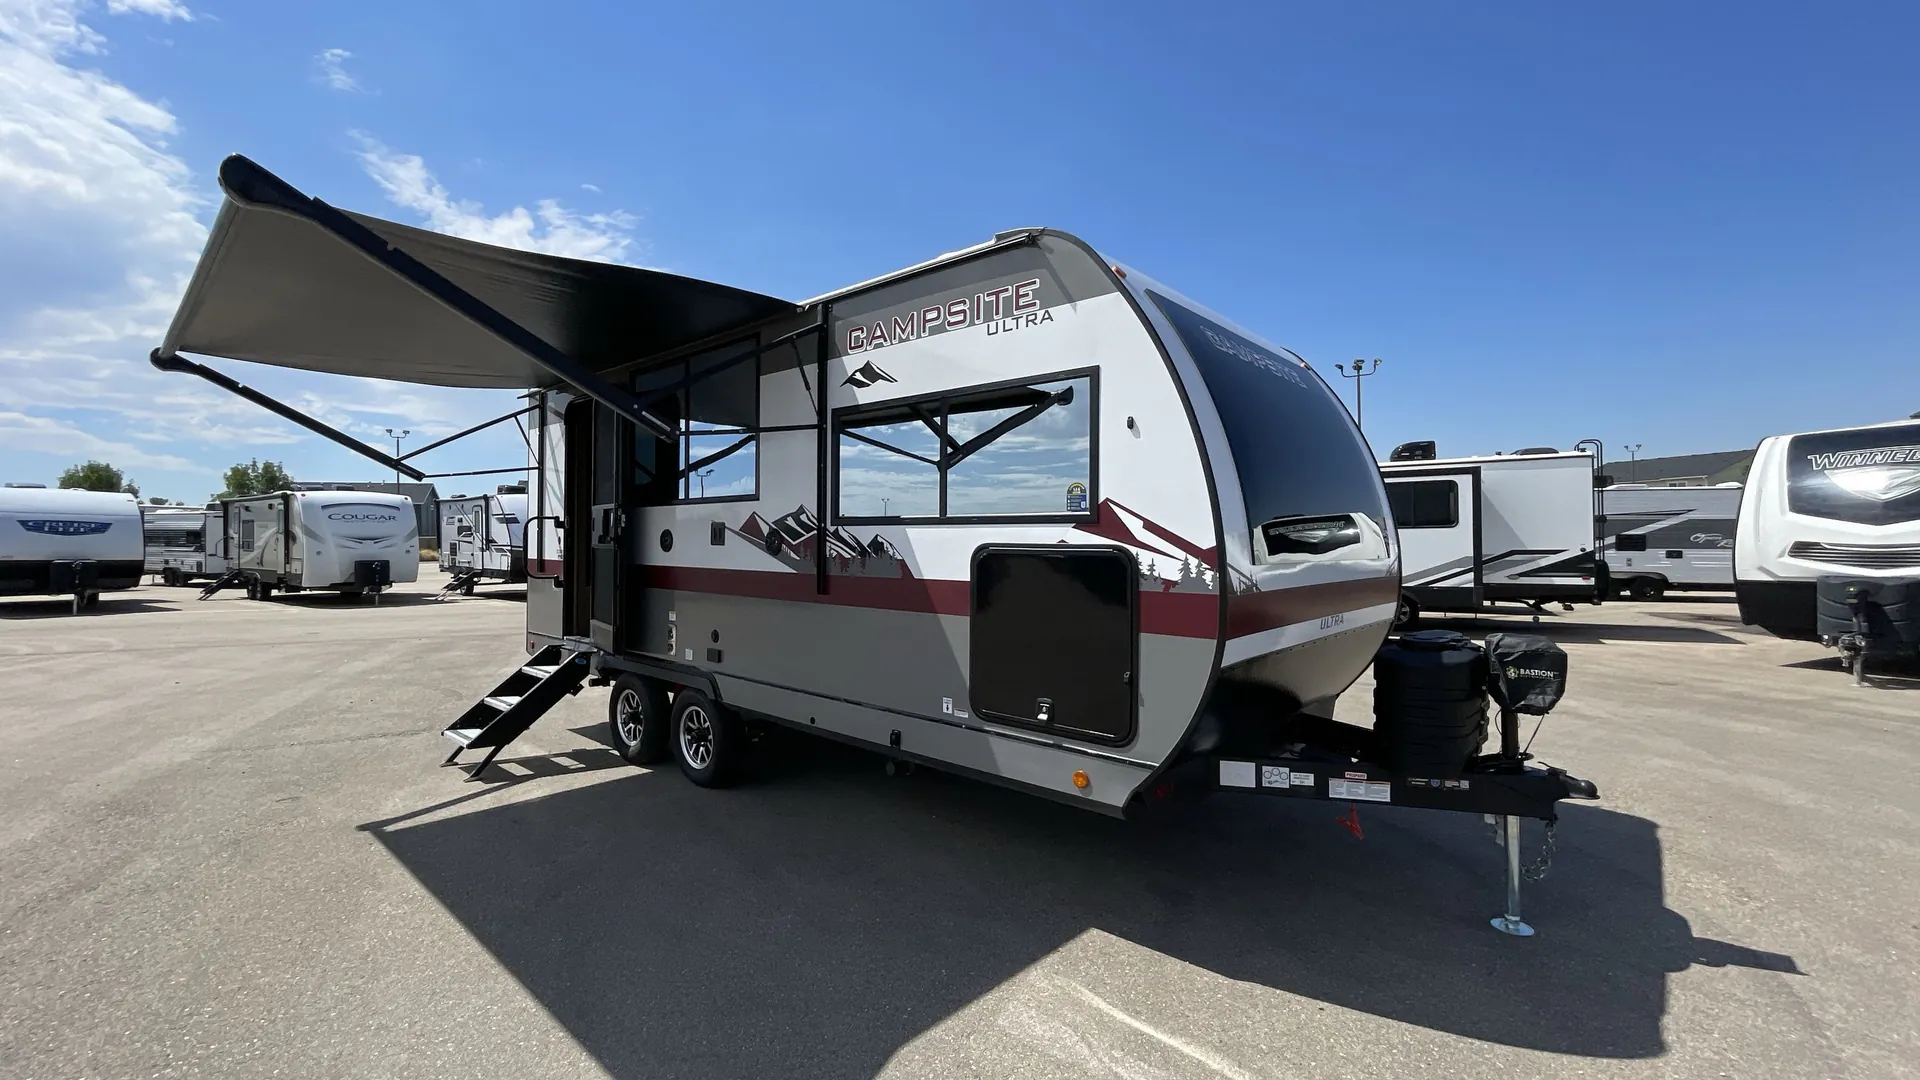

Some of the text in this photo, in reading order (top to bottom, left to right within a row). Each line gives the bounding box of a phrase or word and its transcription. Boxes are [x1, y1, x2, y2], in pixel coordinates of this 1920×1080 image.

[847, 278, 1040, 355] CAMPSITE
[987, 310, 1054, 336] ULTRA
[1200, 325, 1308, 389] CAMPSITE
[327, 513, 397, 521] COUGAR
[1320, 614, 1345, 630] ULTRA
[1520, 668, 1554, 678] BASTION
